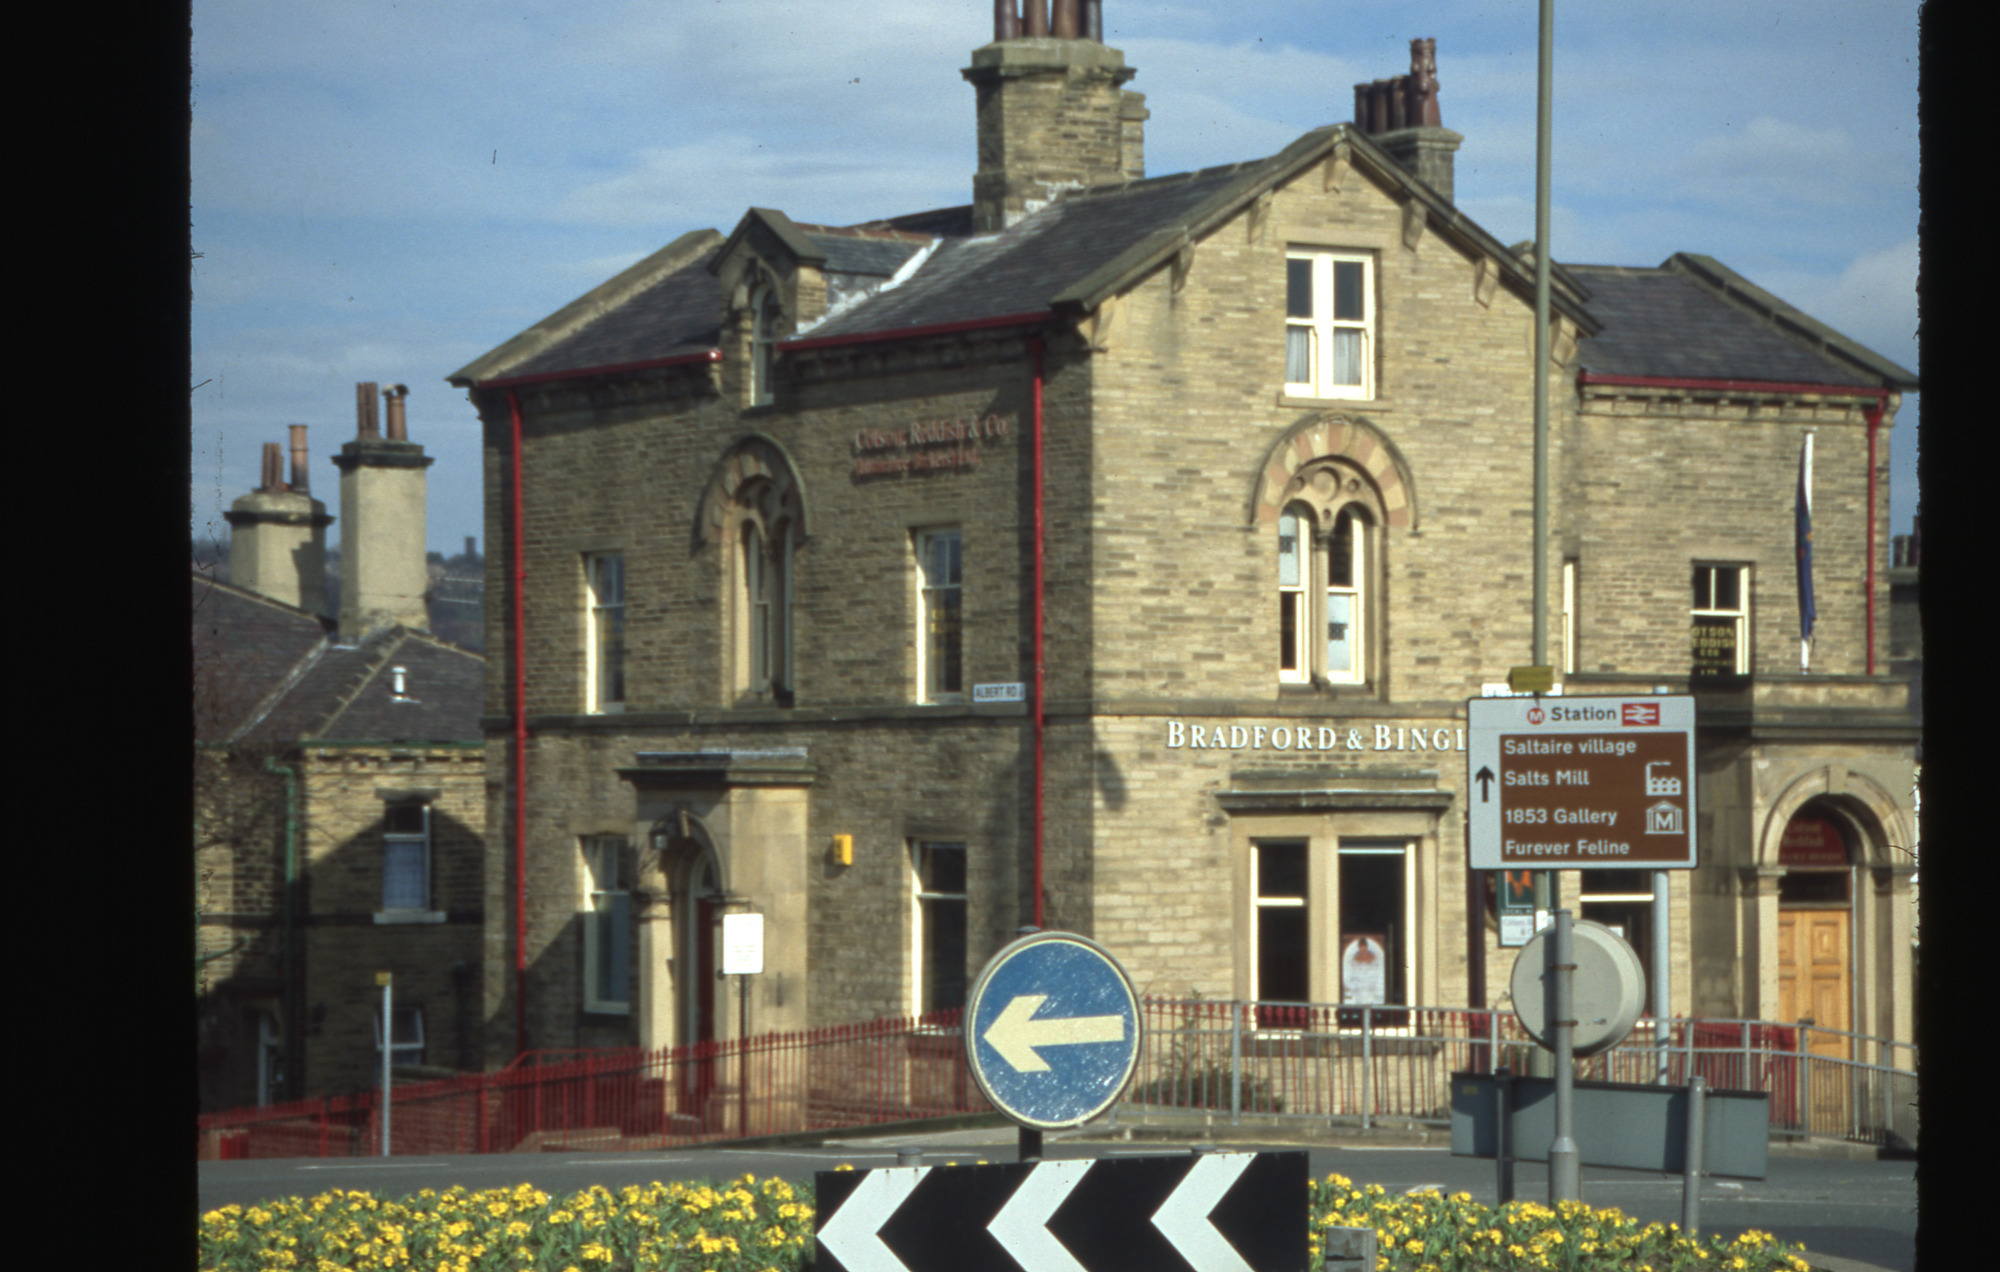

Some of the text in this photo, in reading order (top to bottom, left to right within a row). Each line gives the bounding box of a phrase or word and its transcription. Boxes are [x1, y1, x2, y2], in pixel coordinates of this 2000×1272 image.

[968, 414, 981, 438] &
[976, 687, 1004, 699] ALBERT
[1551, 706, 1617, 721] Station
[1167, 721, 1467, 750] BRADFORD & BINGL
[1504, 738, 1637, 756] Saltaire village
[1504, 770, 1590, 786] Salts Mill
[1505, 808, 1618, 827] 1853 Gallery
[1505, 839, 1630, 855] Furever Feline
